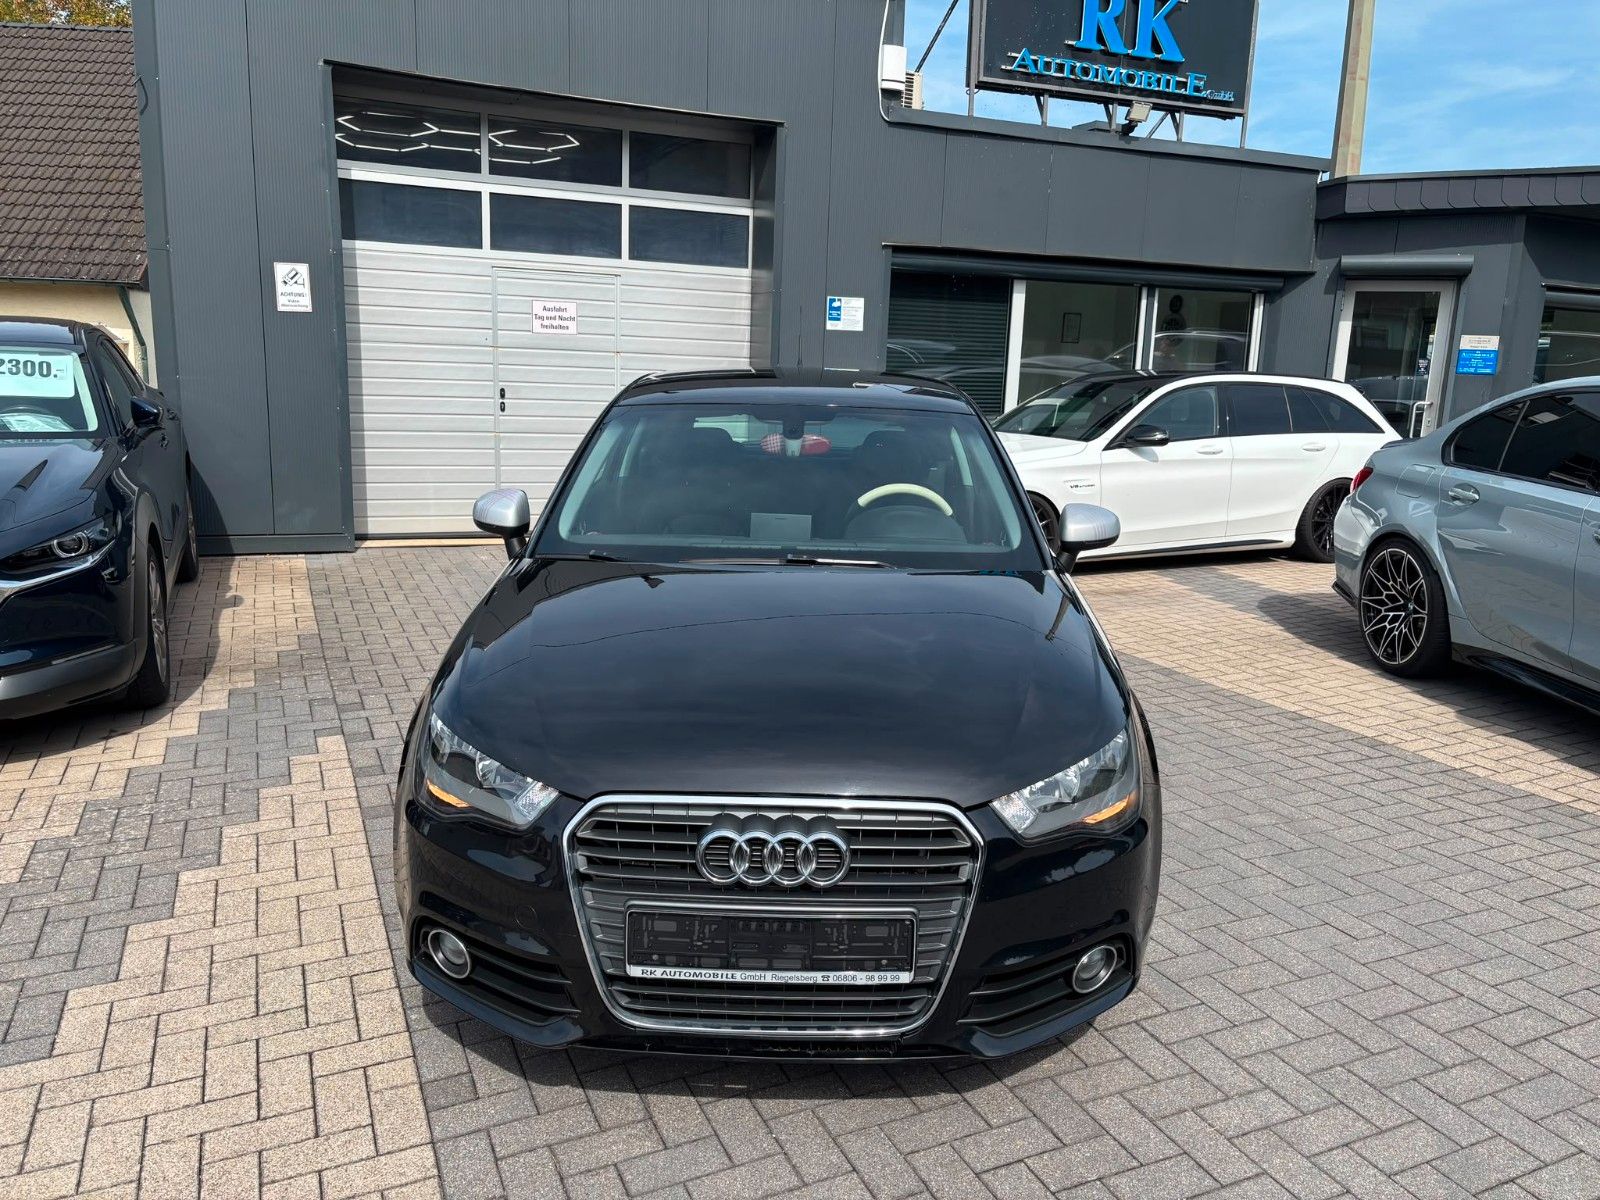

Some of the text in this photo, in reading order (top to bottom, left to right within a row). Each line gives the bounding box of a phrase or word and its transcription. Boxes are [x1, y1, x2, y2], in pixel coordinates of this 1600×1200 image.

[1074, 0, 1186, 62] RK
[640, 968, 657, 977] RK
[660, 969, 737, 980] AUTOMOBILE
[739, 973, 766, 981] GmbH
[771, 973, 818, 984] Riegelsberg
[832, 974, 858, 982] 06806
[865, 974, 876, 982] 98
[877, 974, 888, 982] 99
[889, 974, 901, 982] 99
